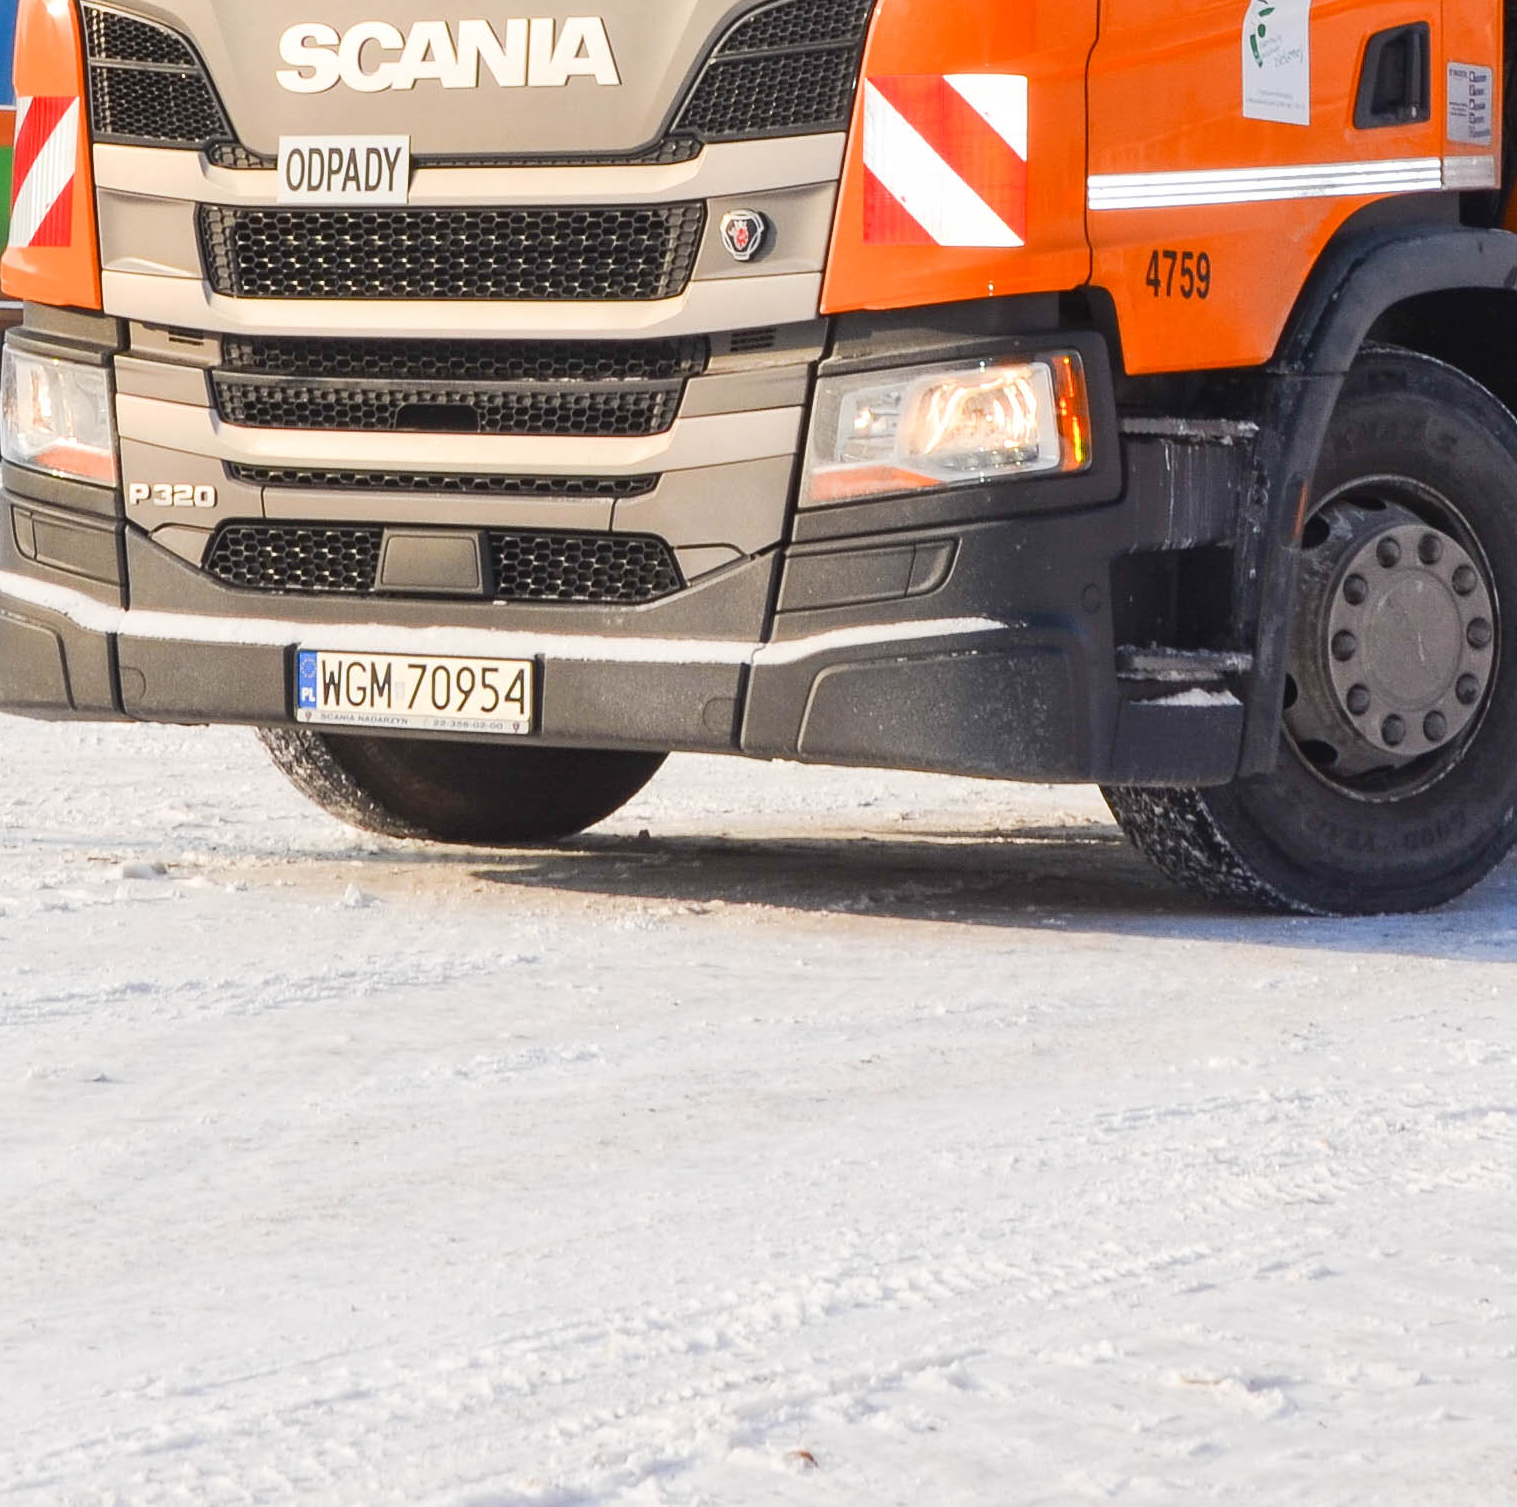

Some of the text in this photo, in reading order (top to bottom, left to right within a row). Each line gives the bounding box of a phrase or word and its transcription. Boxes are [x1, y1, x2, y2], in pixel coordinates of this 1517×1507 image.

[275, 16, 623, 94] SCANIA
[285, 146, 402, 192] ODPADY
[1146, 249, 1211, 299] 4759
[301, 686, 316, 702] PL
[322, 660, 526, 715] WGM 70954
